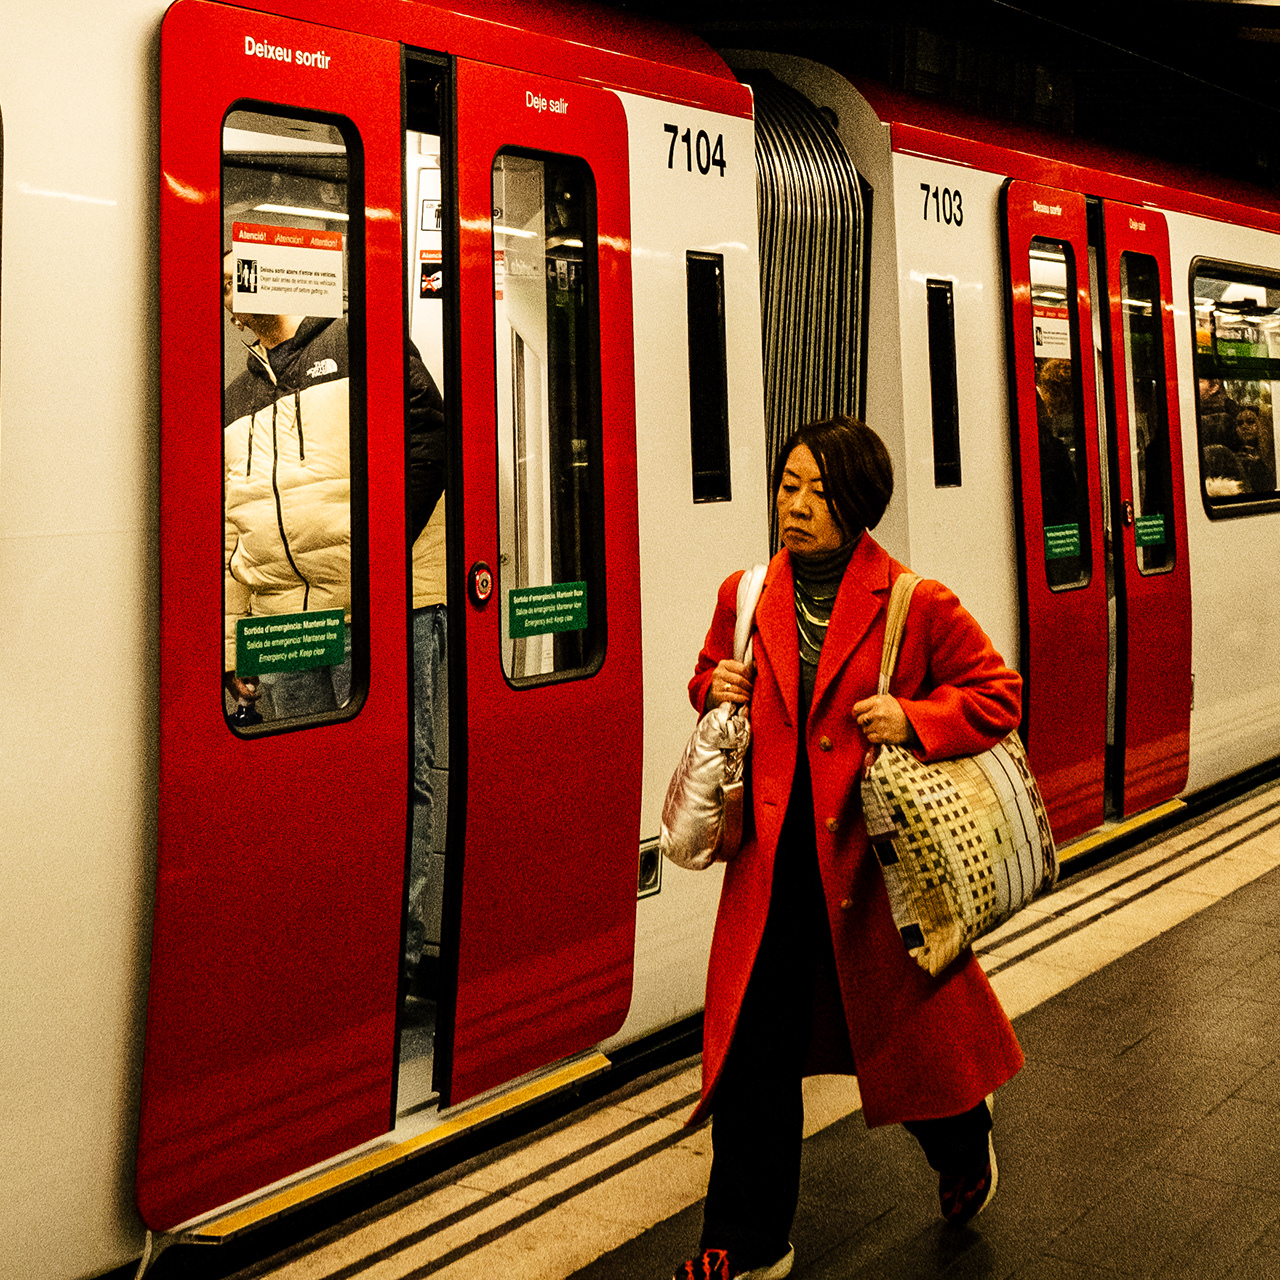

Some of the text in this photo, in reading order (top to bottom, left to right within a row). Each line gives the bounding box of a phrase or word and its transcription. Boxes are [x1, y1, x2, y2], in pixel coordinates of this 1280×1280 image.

[244, 35, 332, 70] Deixeu sortir
[525, 91, 569, 115] Deje salir
[663, 122, 727, 178] 7104
[919, 182, 964, 227] 7103
[238, 230, 267, 241] Atenció!
